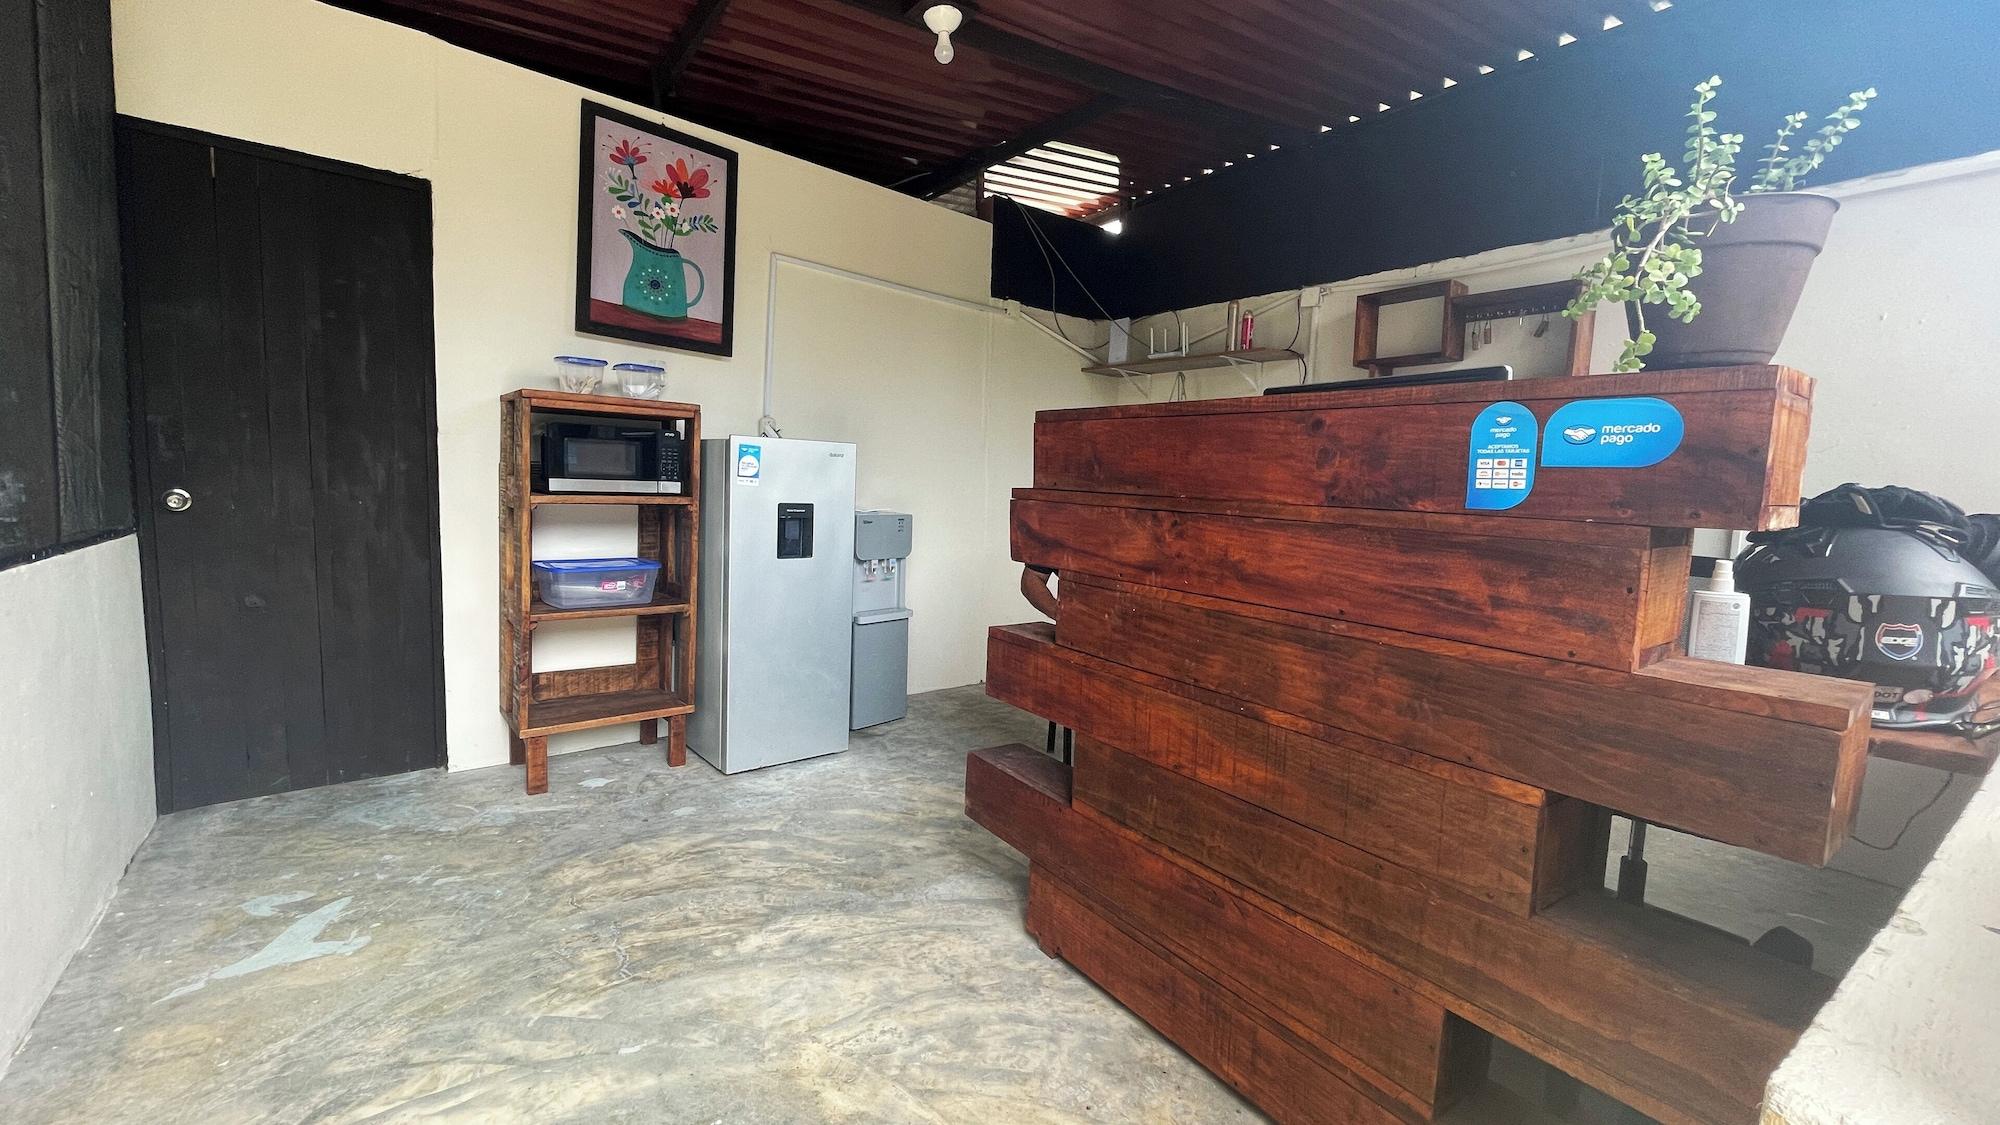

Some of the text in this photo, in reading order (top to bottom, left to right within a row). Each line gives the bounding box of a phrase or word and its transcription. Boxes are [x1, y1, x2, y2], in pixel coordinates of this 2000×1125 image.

[1601, 422, 1661, 434] mercado
[1600, 434, 1633, 446] pago
[1874, 691, 1898, 699] DOT
